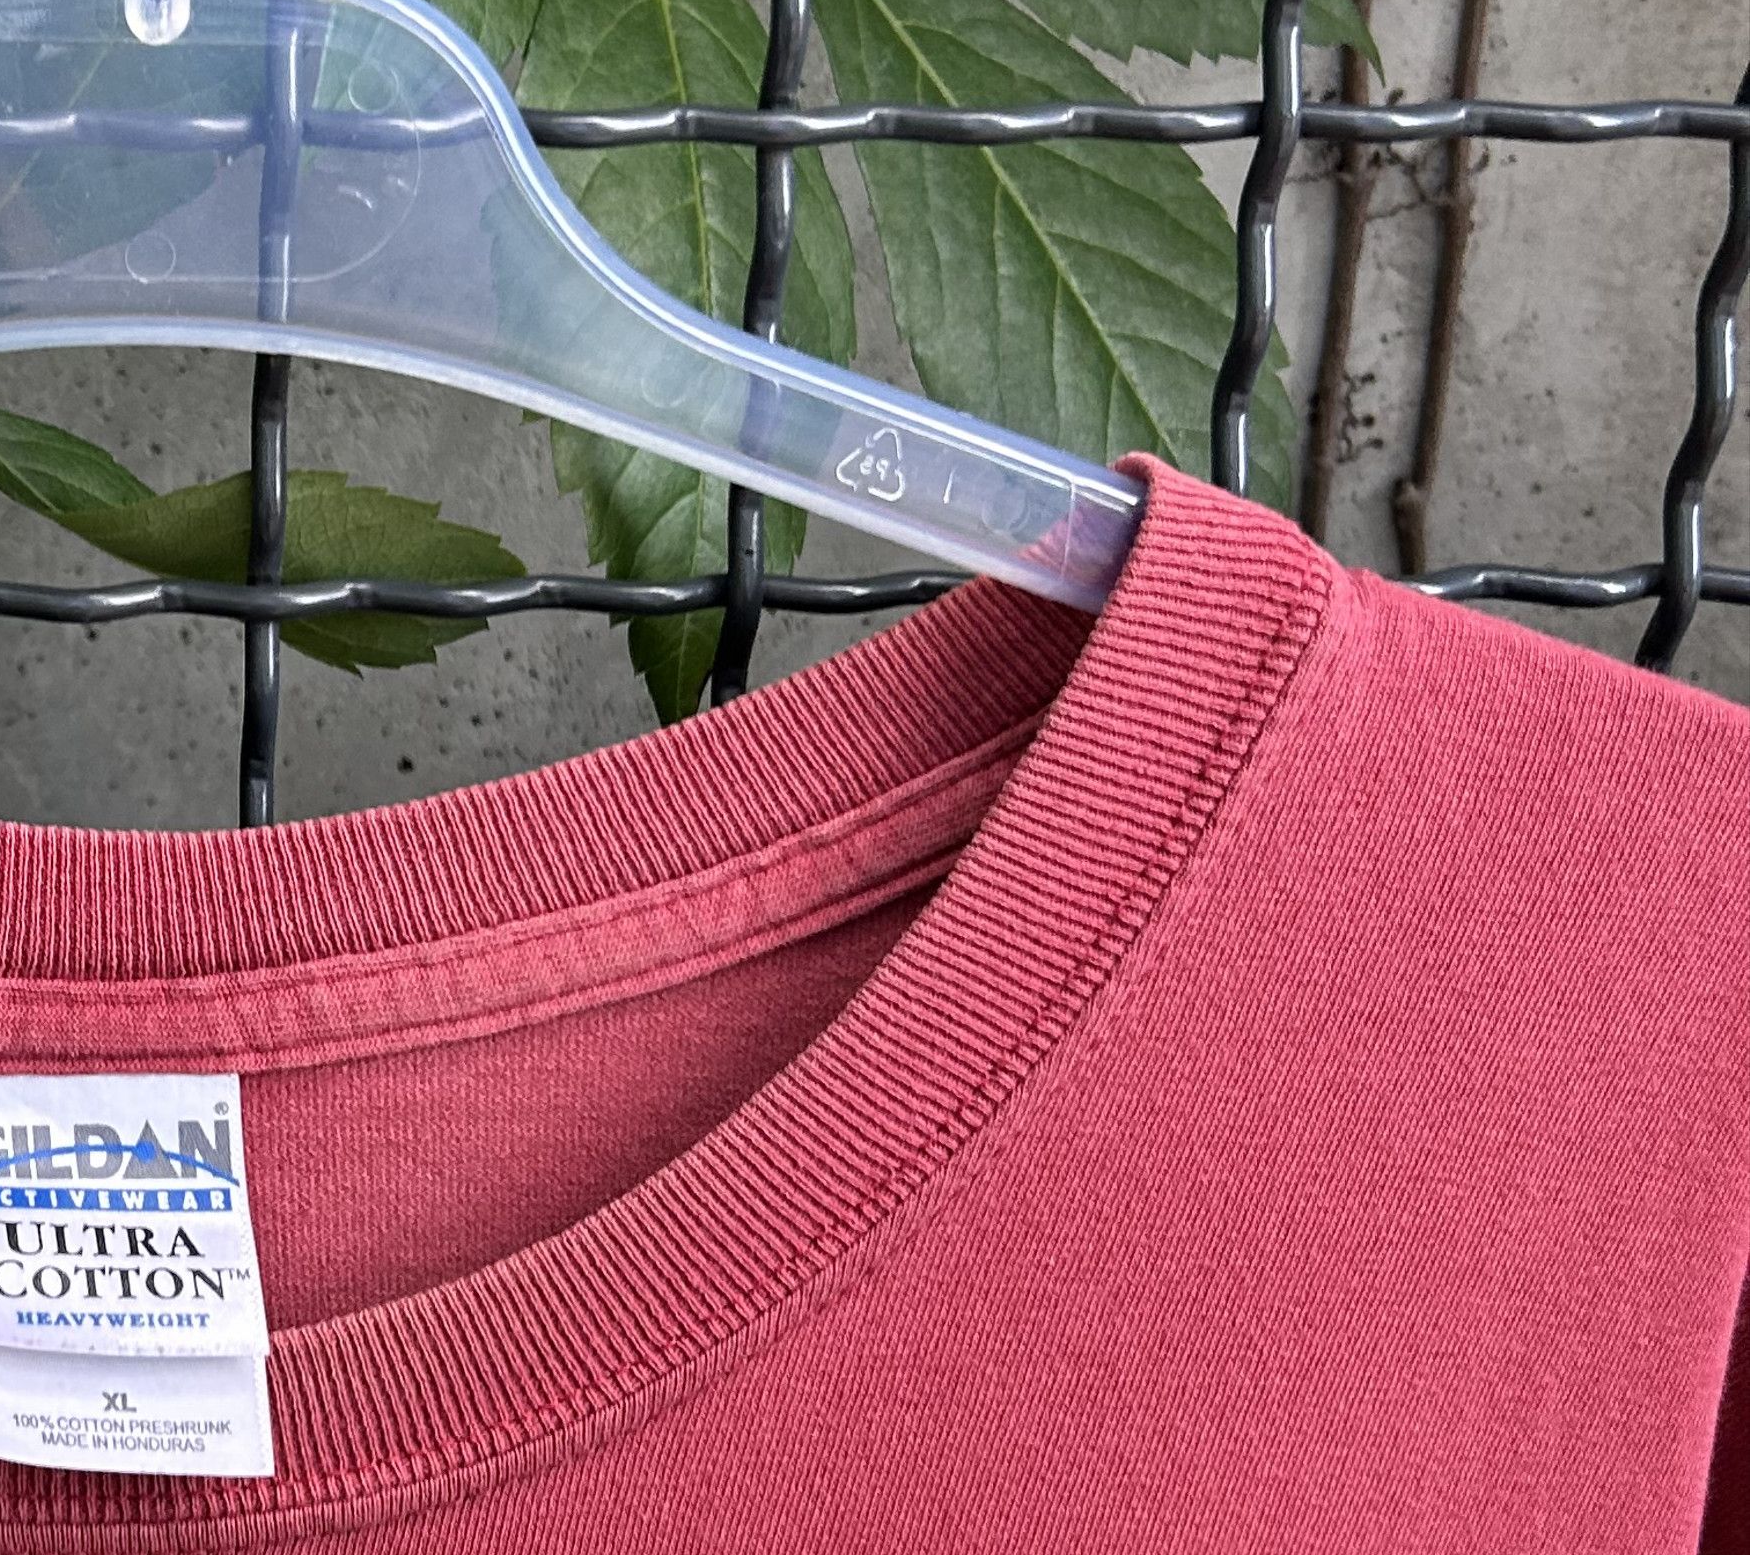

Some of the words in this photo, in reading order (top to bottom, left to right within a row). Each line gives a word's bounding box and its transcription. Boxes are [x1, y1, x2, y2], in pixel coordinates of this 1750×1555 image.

[0, 1220, 206, 1258] ULTRA
[17, 1310, 211, 1328] HEAVYWEIGHT
[102, 1391, 138, 1413] XL
[12, 1414, 54, 1430] 100%
[57, 1416, 126, 1434] COTTON
[130, 1419, 233, 1436] PRESHRUNK
[41, 1430, 89, 1449] MADE
[92, 1434, 109, 1450] IN
[112, 1435, 206, 1453] HONDURAS
